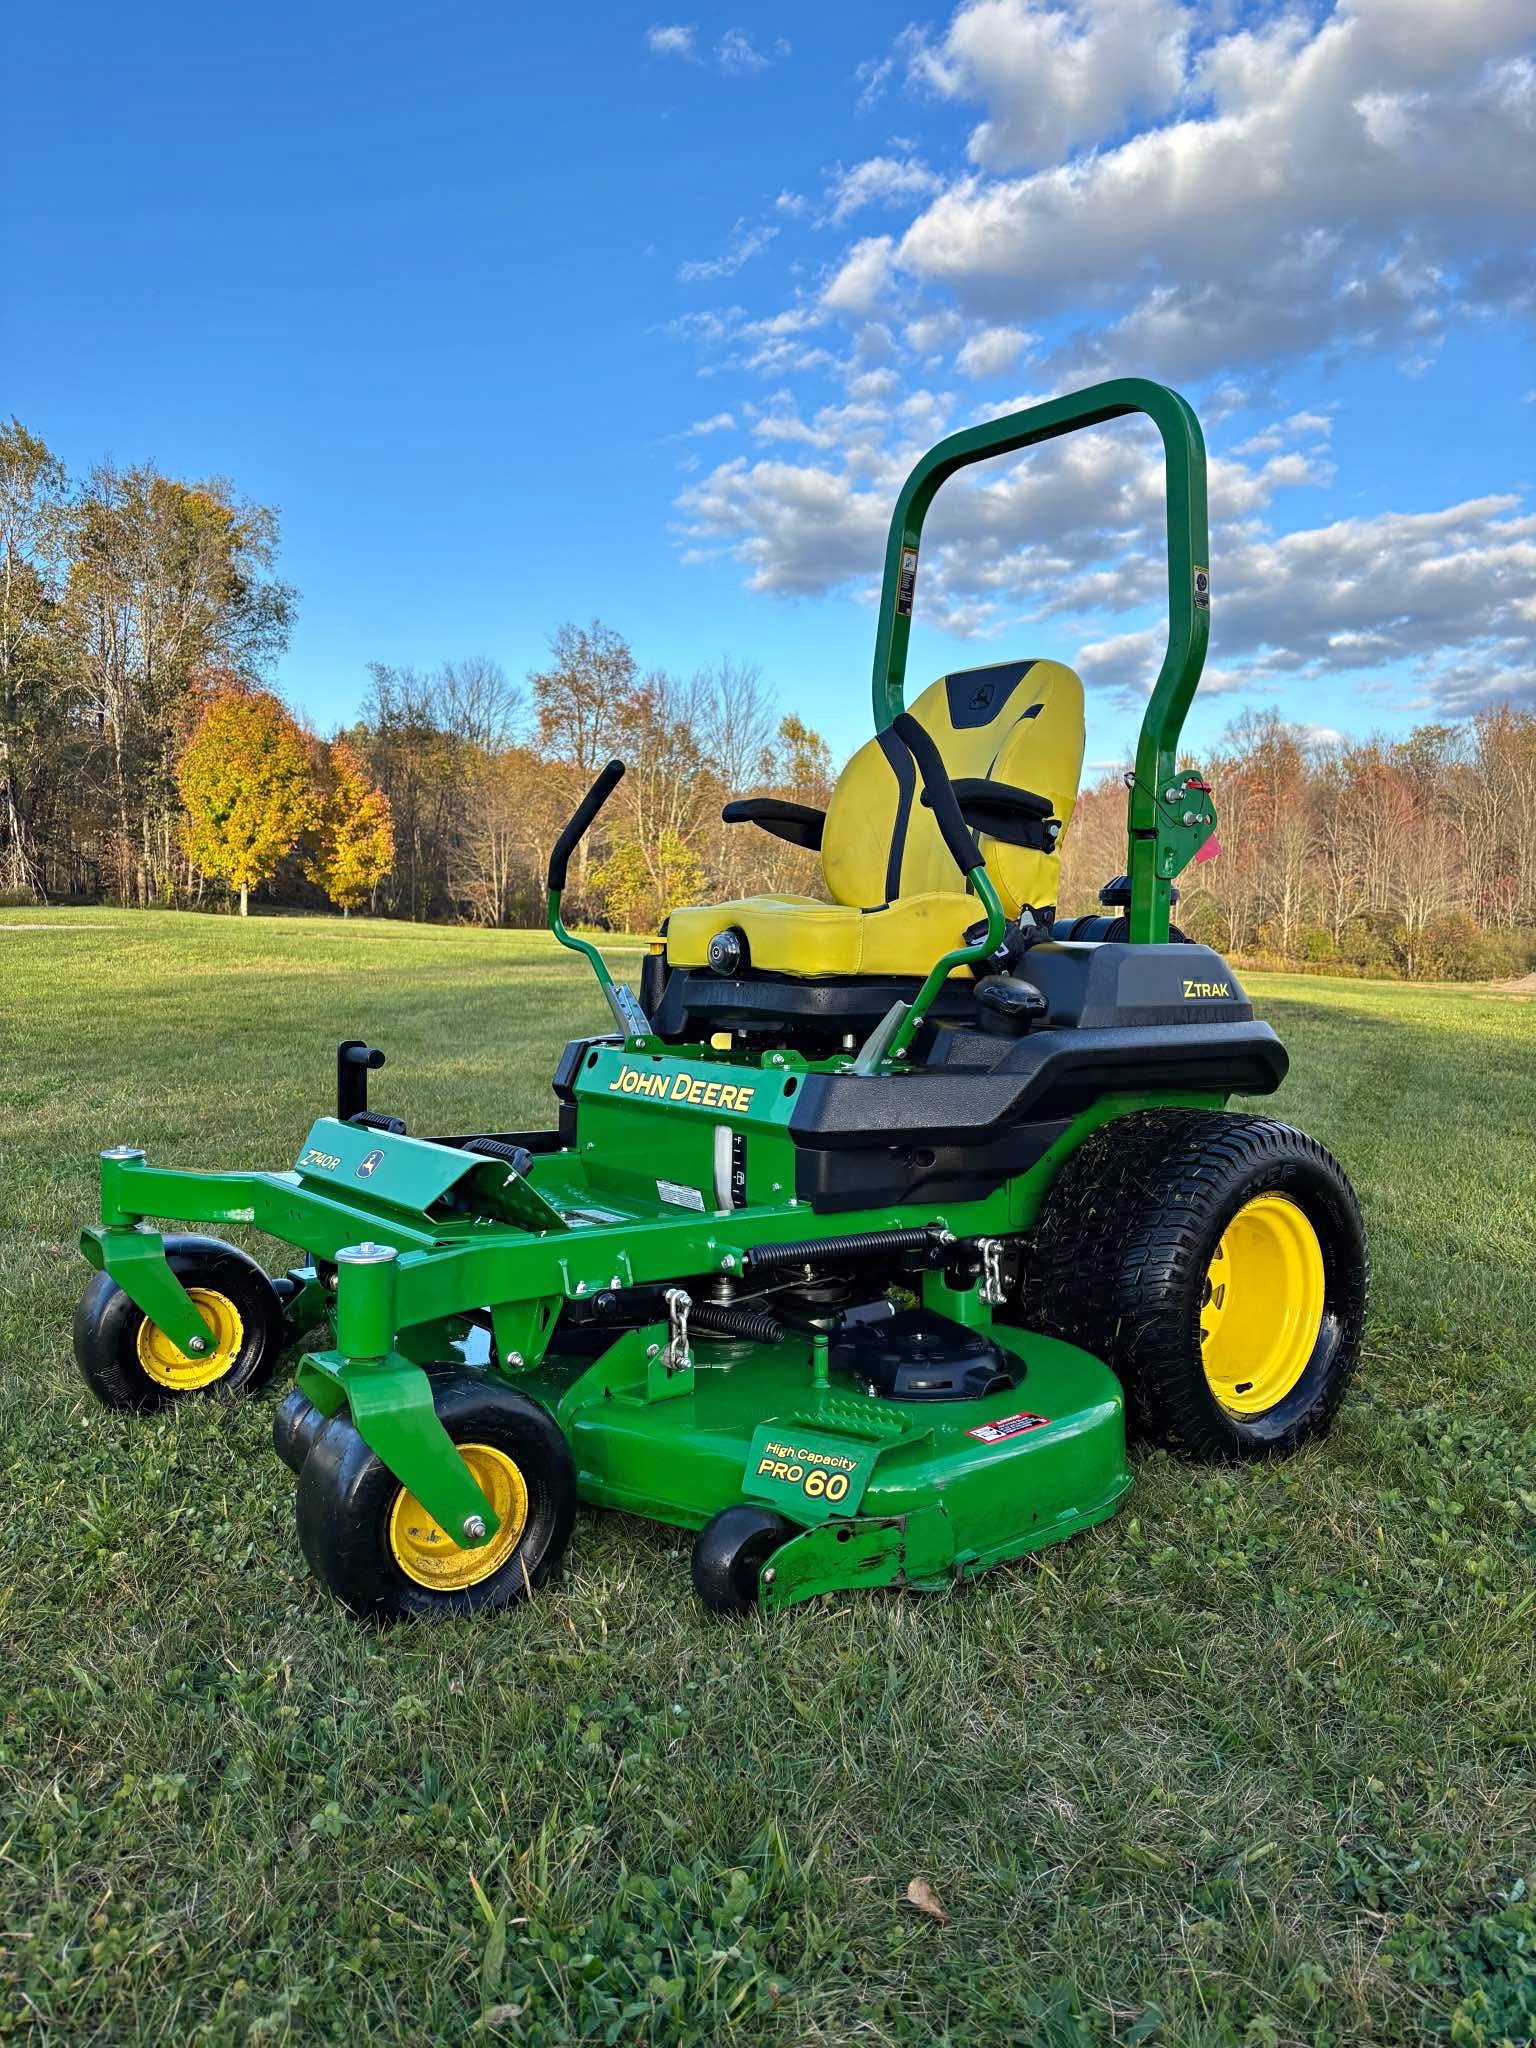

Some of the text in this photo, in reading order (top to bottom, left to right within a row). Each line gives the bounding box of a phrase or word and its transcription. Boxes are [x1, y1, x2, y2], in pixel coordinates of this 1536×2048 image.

[1183, 980, 1230, 998] ZTRAK
[609, 1064, 755, 1113] JOHN DEERE
[299, 1149, 342, 1171] Z740R
[765, 1441, 858, 1472] High Capacity
[757, 1458, 850, 1501] PRO 60
